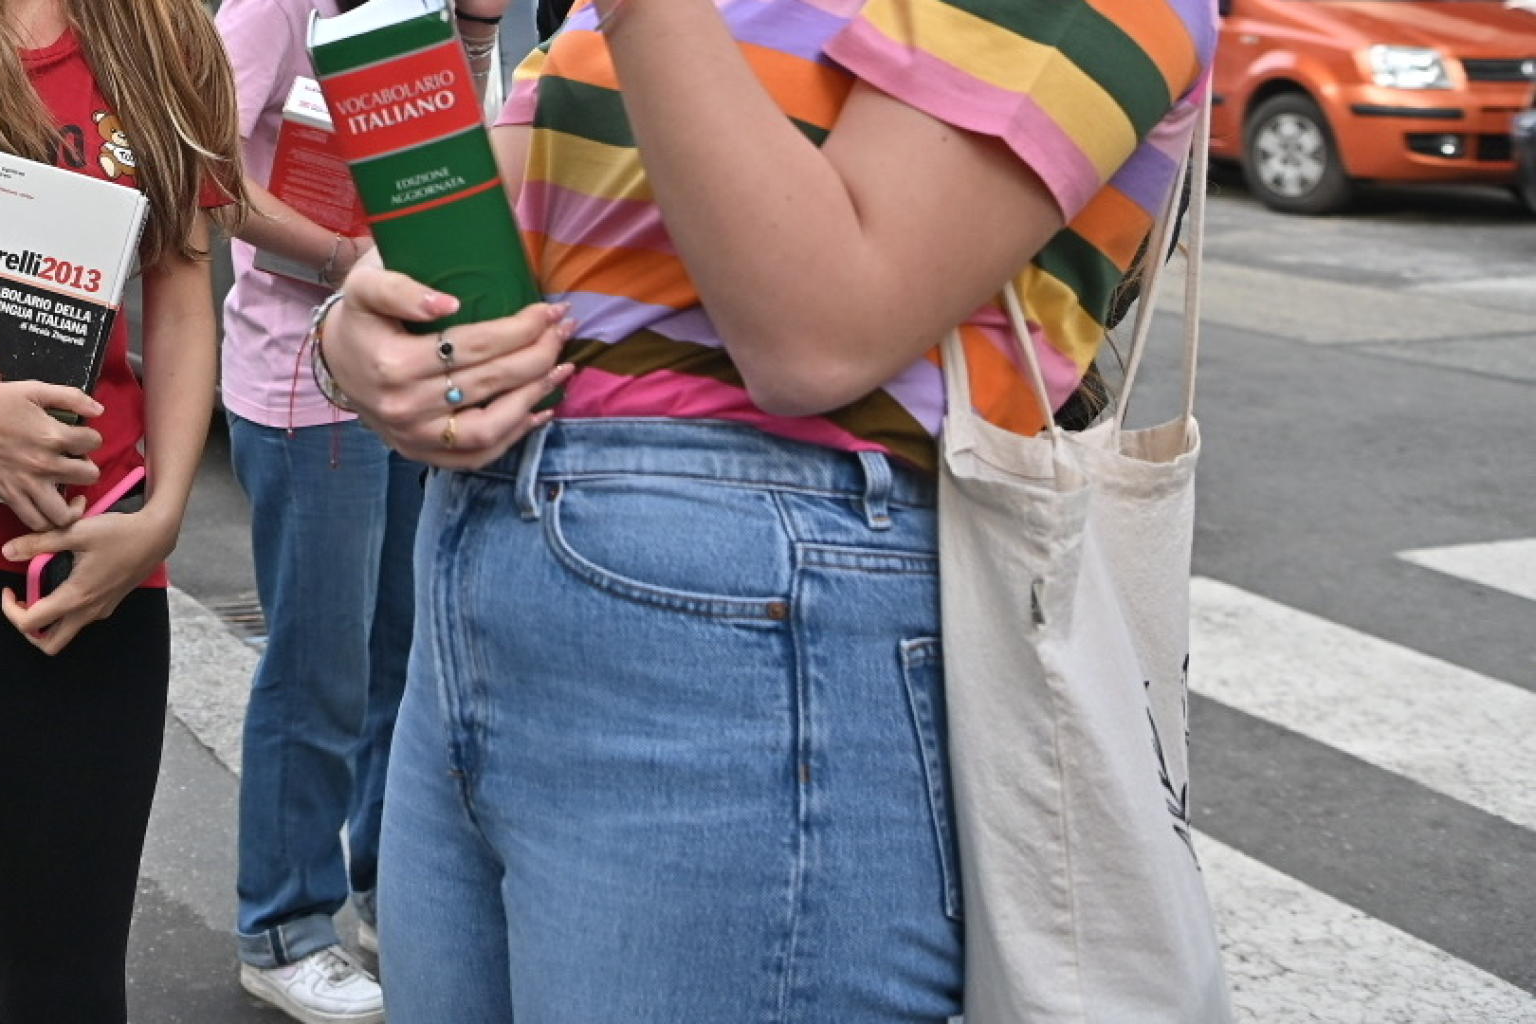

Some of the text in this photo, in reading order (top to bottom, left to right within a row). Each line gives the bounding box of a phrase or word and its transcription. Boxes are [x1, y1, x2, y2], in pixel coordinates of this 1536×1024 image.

[335, 69, 455, 115] VOCABOLARIO
[348, 90, 455, 136] ITALIANO
[35, 310, 88, 336] ITALIANA
[54, 301, 92, 323] DELLA
